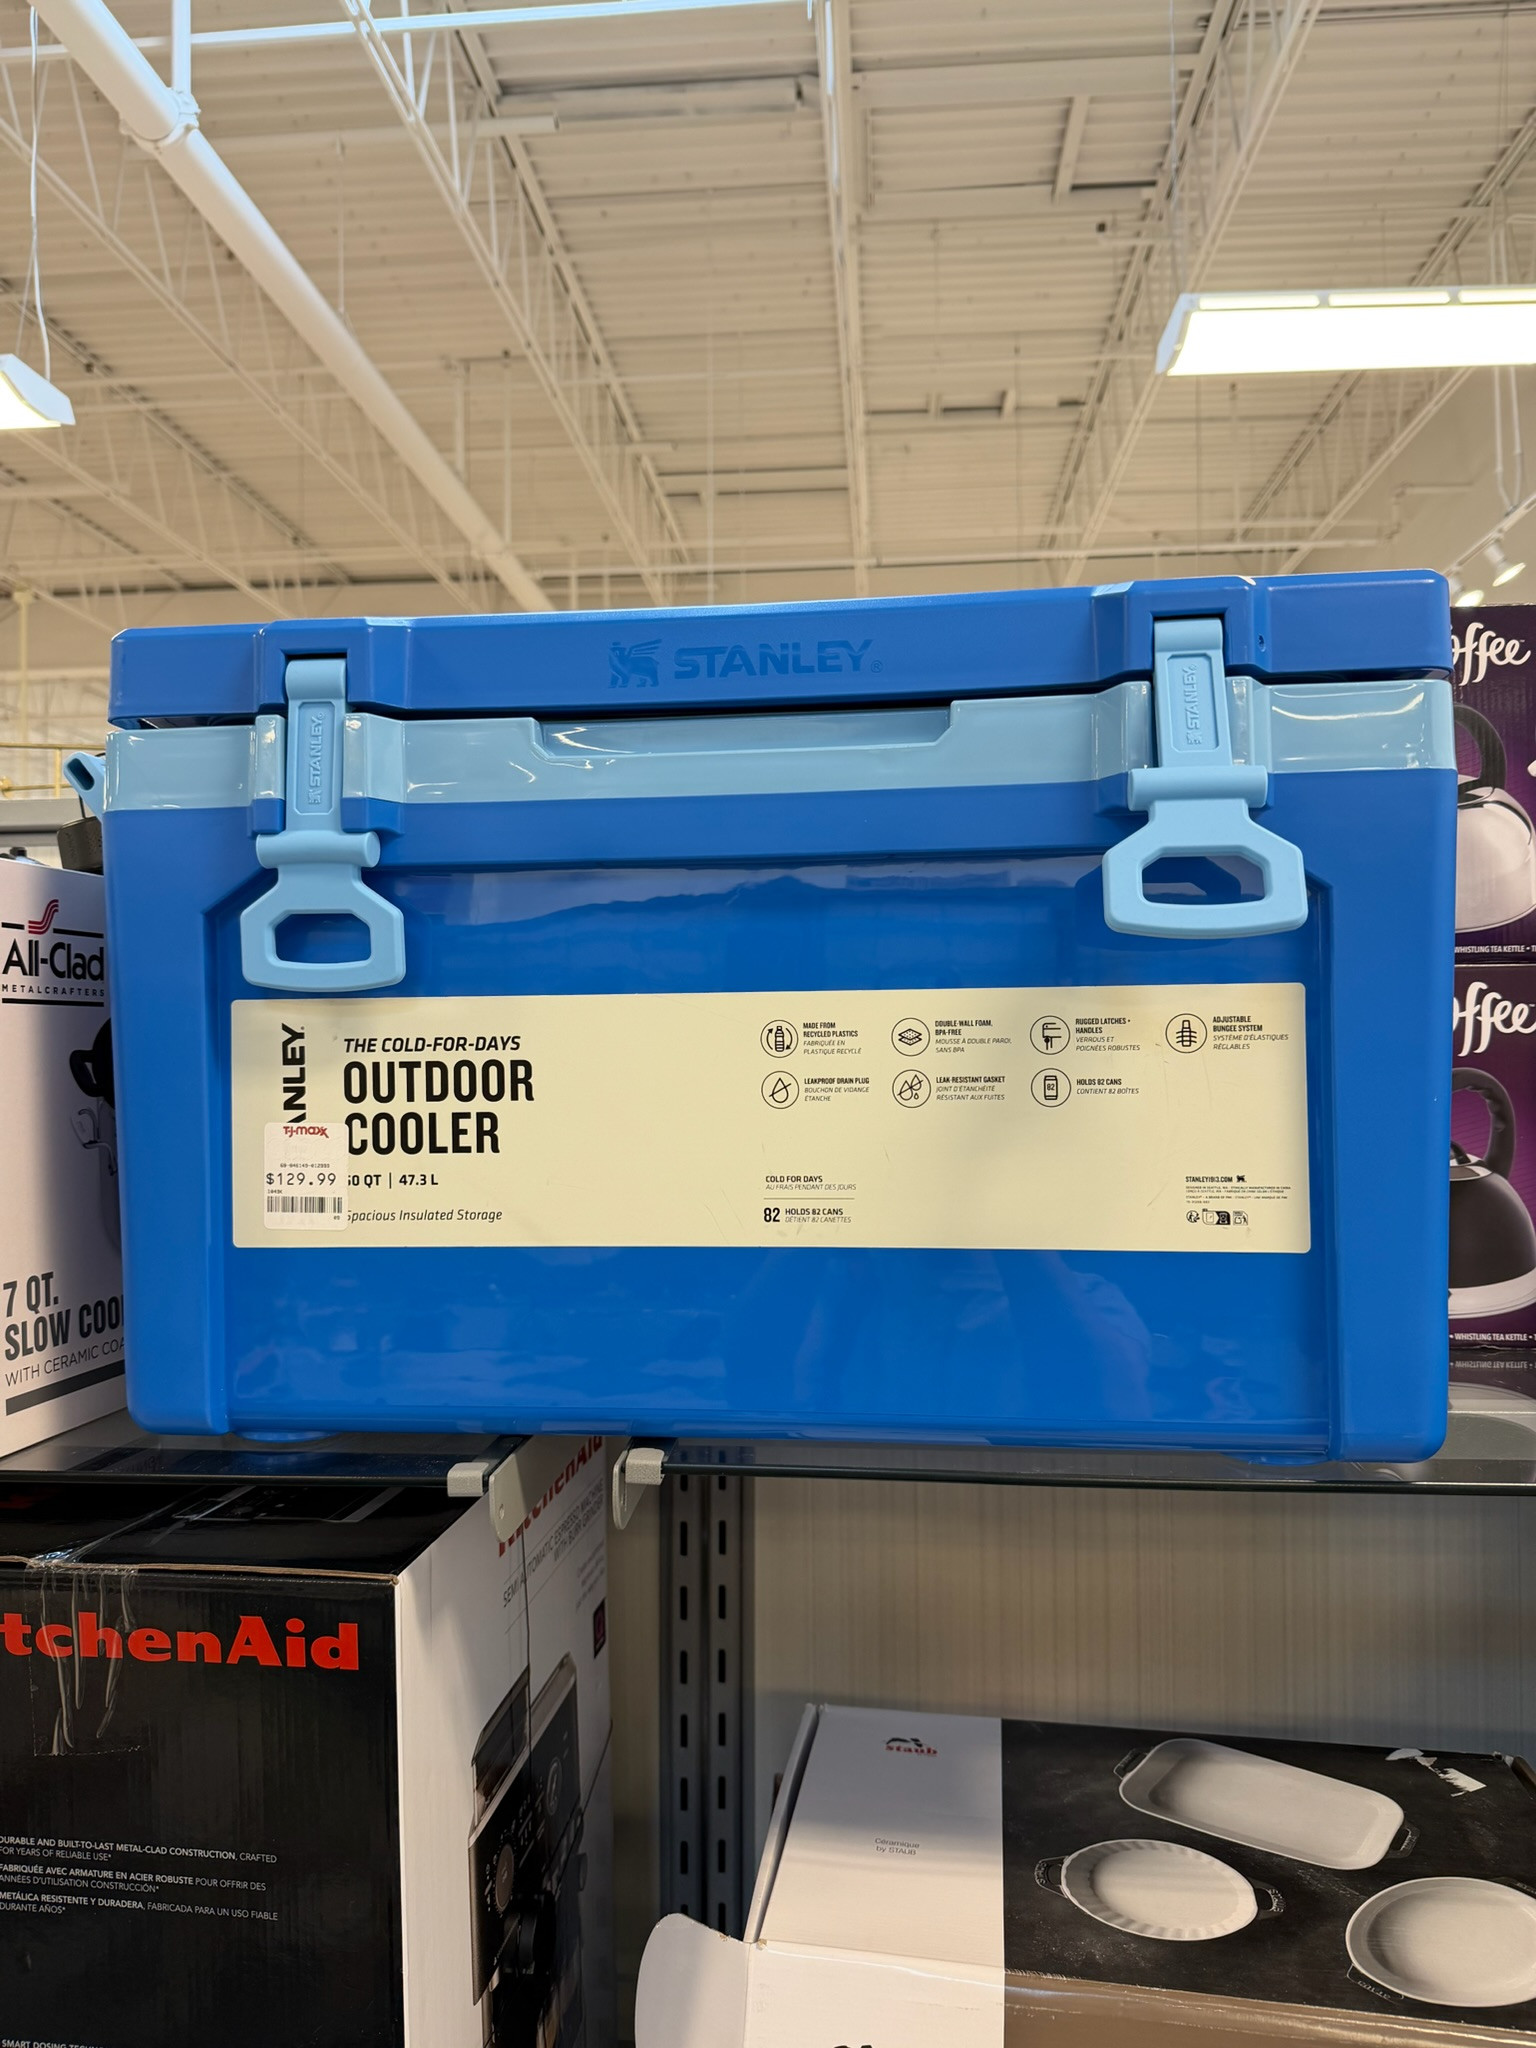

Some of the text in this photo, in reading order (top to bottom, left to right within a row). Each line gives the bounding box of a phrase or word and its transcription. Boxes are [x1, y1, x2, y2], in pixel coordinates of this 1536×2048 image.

[309, 716, 323, 786] STANLEY
[1454, 945, 1489, 953] WHISTLING
[1491, 945, 1502, 953] TEA
[2, 938, 104, 981] All-Clad
[2, 984, 104, 997] METALCRAFTERS
[1238, 1024, 1263, 1032] SYSTEM
[344, 1036, 521, 1053] THE COLD-FOR-DAYS
[281, 1023, 307, 1123] NLEY
[343, 1059, 535, 1104] OUTDOOR
[1046, 1083, 1055, 1091] 82
[344, 1111, 500, 1155] COOLER
[266, 1172, 336, 1186] $129.99
[364, 1174, 382, 1188] QT
[399, 1174, 439, 1186] 47.3 L
[786, 1175, 802, 1183] FOR
[803, 1175, 823, 1183] DAYS
[399, 1209, 453, 1222] Insulated
[457, 1209, 502, 1223] Storage
[763, 1207, 780, 1223] 82
[785, 1208, 810, 1216] HOLDS
[3, 1271, 59, 1317] 7 QT.
[5, 1309, 71, 1361] SLOW
[1454, 1333, 1528, 1341] WHISTLING TEA KETTLE
[5, 1364, 40, 1387] WITH
[44, 1345, 99, 1374] CERAMIC
[0, 1612, 359, 1670] tchenAid
[885, 1745, 938, 1757] staub
[874, 1837, 920, 1849] Céramique
[16, 1847, 41, 1857] YEARS
[42, 1849, 54, 1857] OF
[56, 1850, 92, 1860] RELIABLE
[37, 1838, 56, 1847] AND
[58, 1839, 114, 1851] BUILT-TO-LAST
[116, 1844, 168, 1855] METAL-CLAD
[169, 1847, 238, 1861] CONSTRUCTION,
[239, 1852, 277, 1864] CRAFTED
[876, 1845, 916, 1856] by STAUB
[32, 1876, 89, 1888] D'UTILISATION
[45, 1867, 68, 1876] AVEC
[69, 1868, 114, 1879] ARMATURE
[116, 1871, 127, 1880] EN
[129, 1872, 154, 1882] ACIER
[155, 1875, 194, 1885] ROBUSTE
[195, 1878, 218, 1887] POUR
[220, 1879, 248, 1890] OFFRIR
[250, 1882, 266, 1891] DES
[0, 1902, 37, 1913] DURANTE
[41, 1894, 88, 1906] RESISTENTE
[90, 1898, 96, 1906] Y
[98, 1898, 146, 1910] DURADERA,
[147, 1902, 193, 1913] FABRICADA
[194, 1906, 216, 1915] PARA
[216, 1907, 230, 1916] UN
[231, 1909, 249, 1918] USO
[250, 1911, 279, 1921] FIABLE
[2, 2039, 31, 2048] SMART
